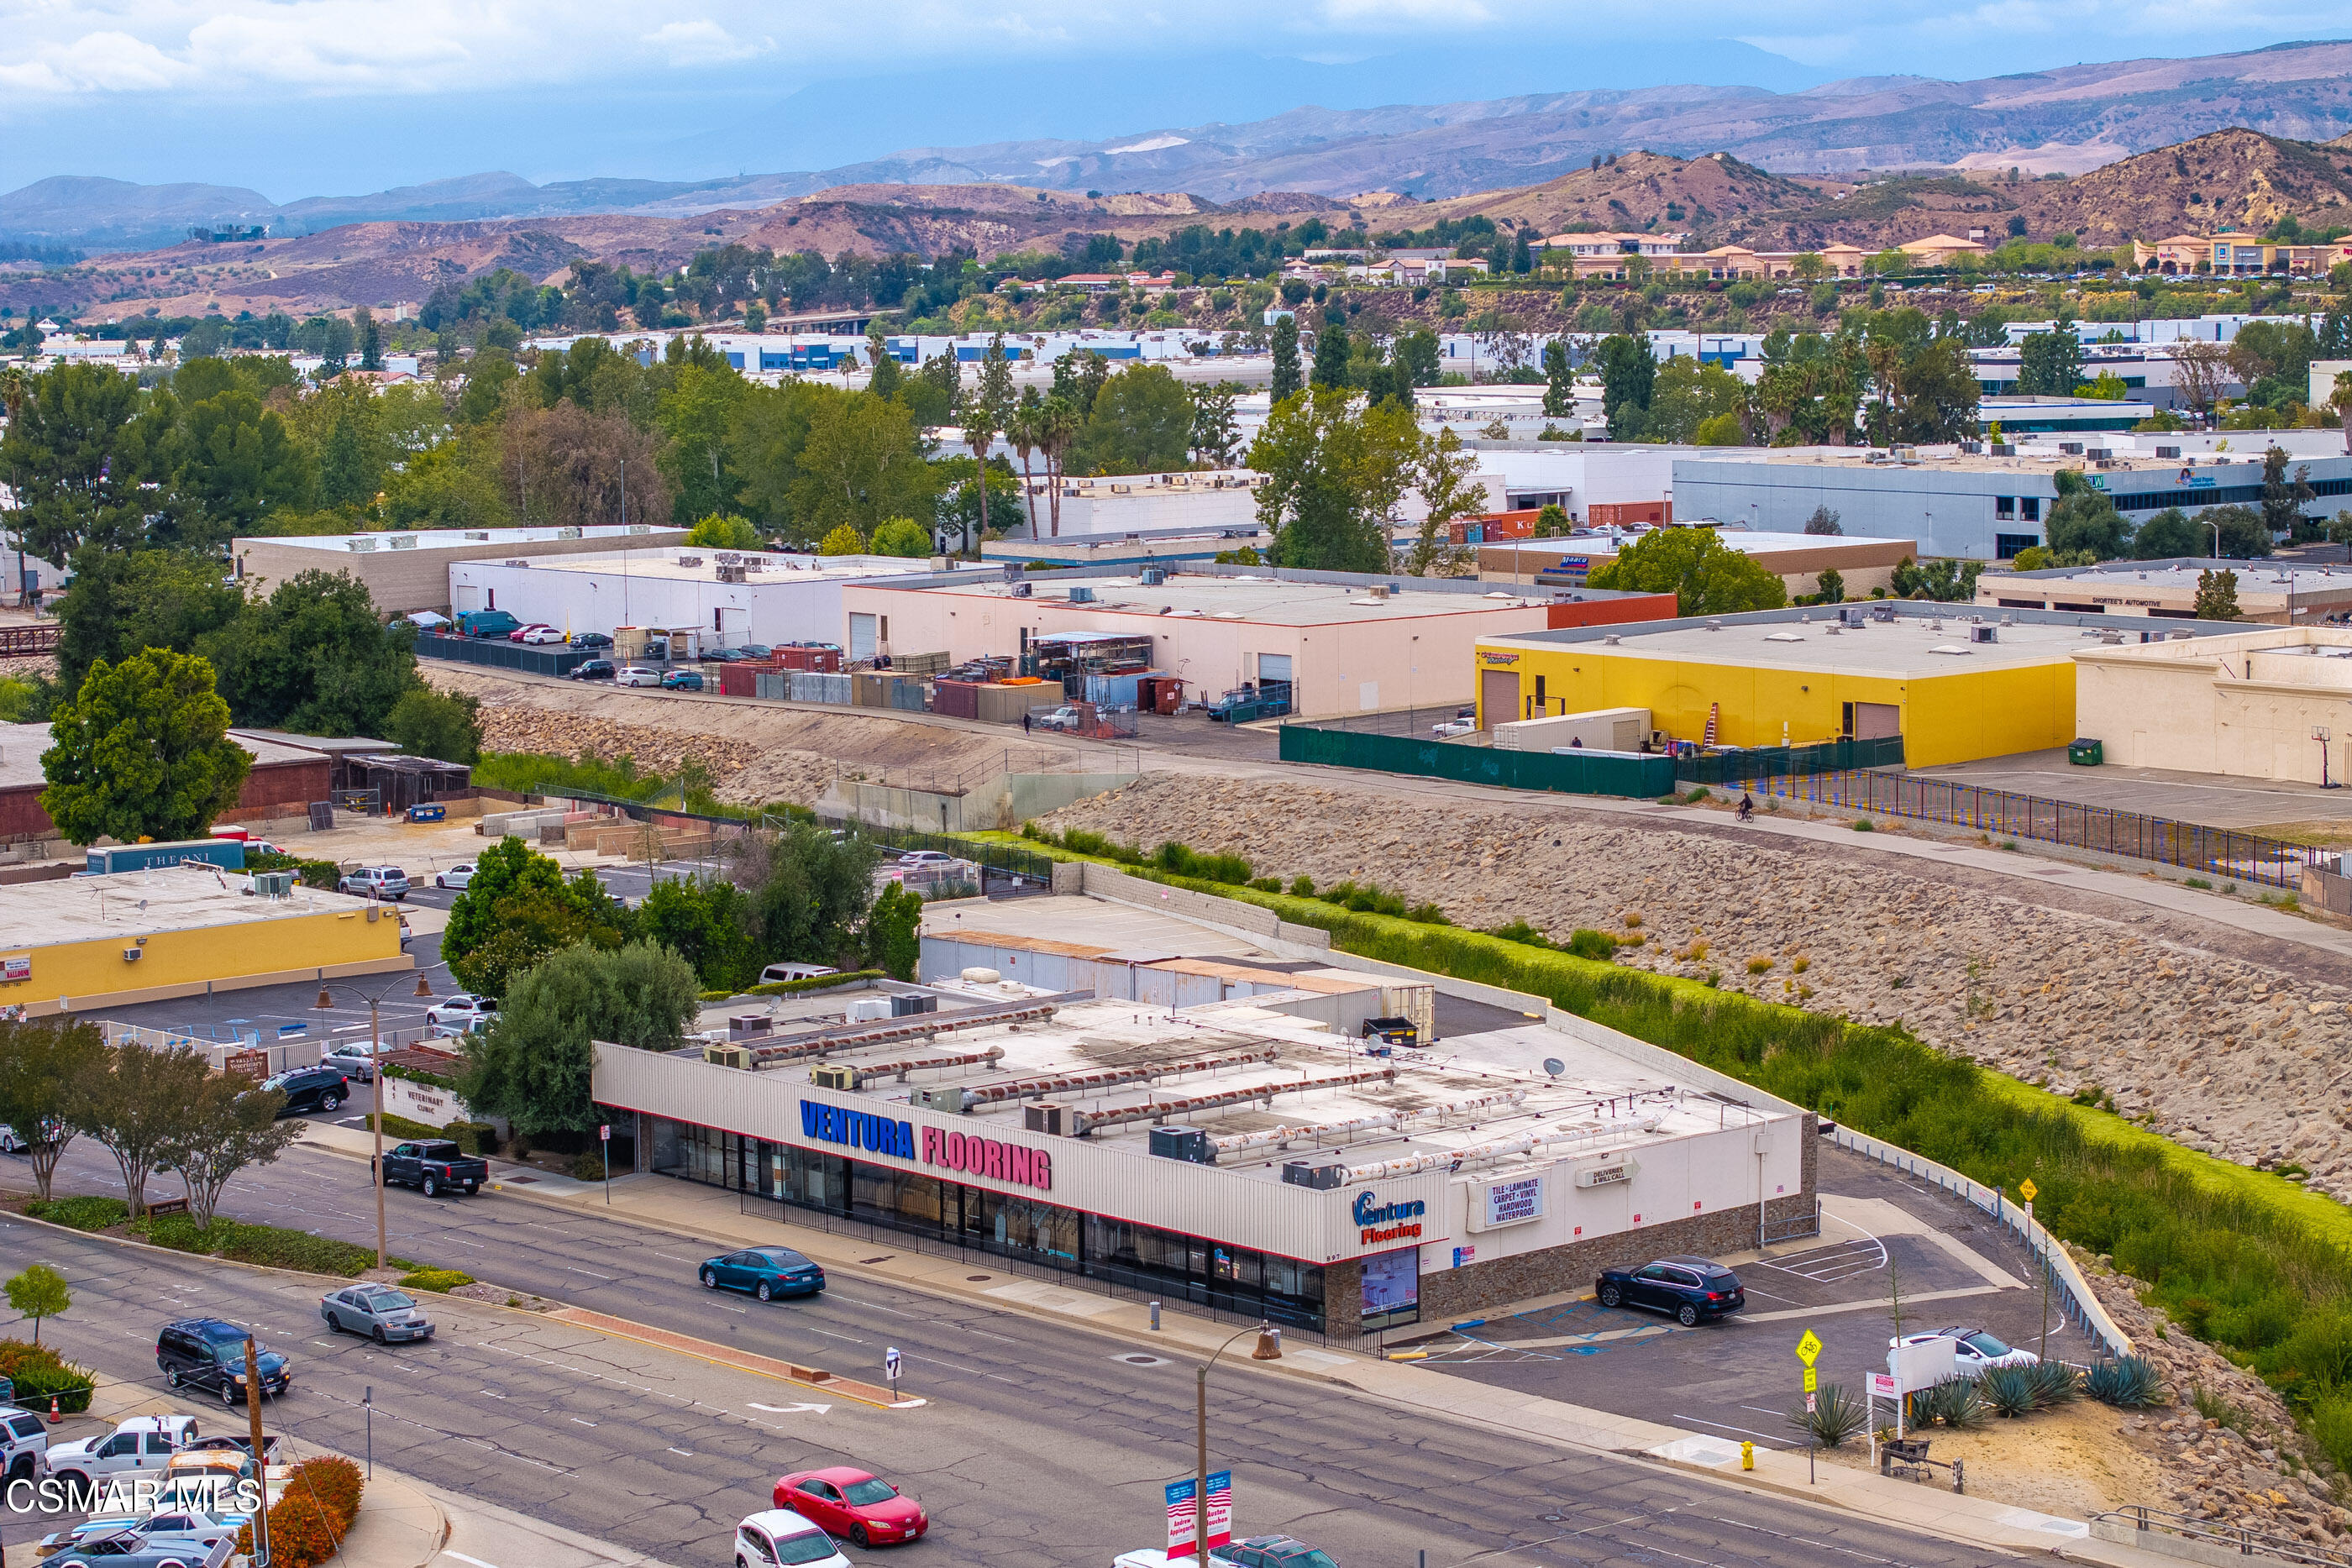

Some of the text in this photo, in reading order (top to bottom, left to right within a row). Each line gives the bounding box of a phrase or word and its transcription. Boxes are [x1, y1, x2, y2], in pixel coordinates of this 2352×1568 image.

[2125, 599, 2161, 607] AUTOMOTIVE
[144, 853, 209, 866] THEONI
[408, 1090, 444, 1107] VETERINARY
[417, 1104, 435, 1114] CLINIC
[800, 1099, 916, 1160] VENTURA
[922, 1125, 1053, 1190] FLOORING
[1593, 1167, 1624, 1178] DELIVERIES
[1598, 1175, 1611, 1183] WILL
[1611, 1172, 1625, 1181] CALL
[1493, 1178, 1539, 1196] TILE LAMINATE
[1494, 1188, 1537, 1204] CARPET VINYL
[1352, 1190, 1425, 1226] Ventura
[1499, 1198, 1533, 1213] HARDWOOD
[1496, 1207, 1536, 1222] WATERPROOF
[1361, 1222, 1422, 1245] Flooring
[1207, 1508, 1226, 1518] Austen
[1173, 1518, 1191, 1527] Andrew
